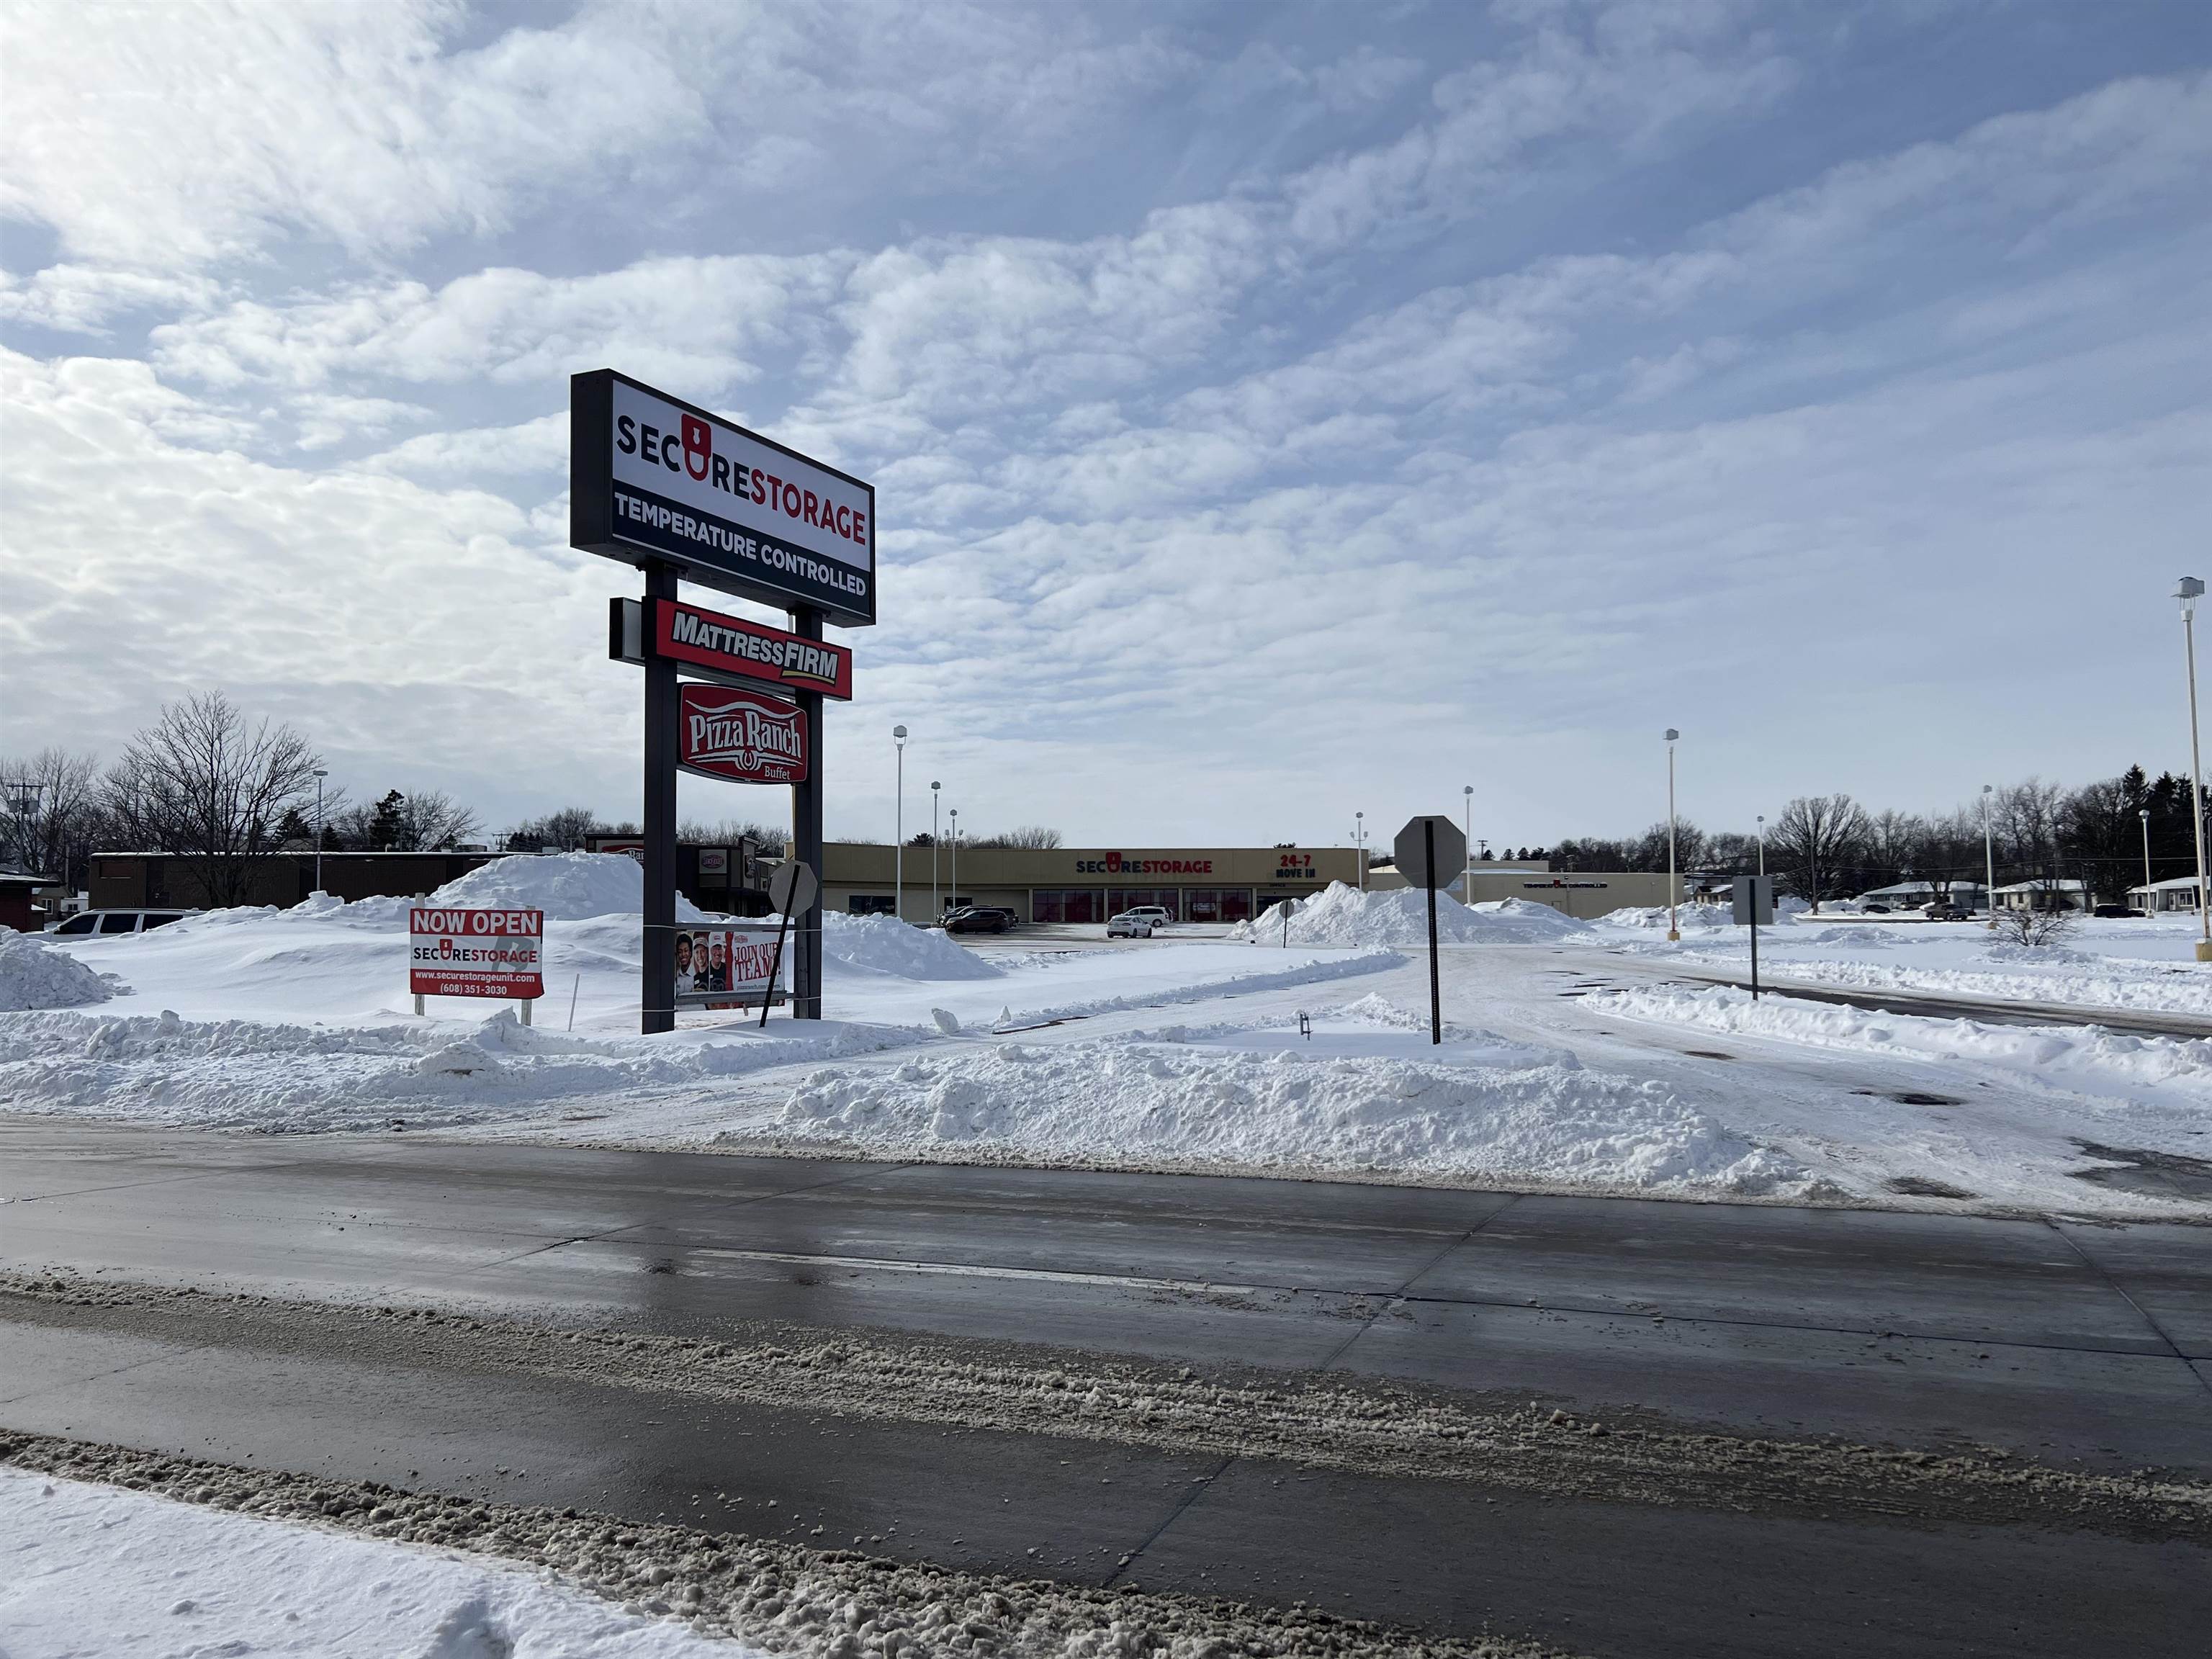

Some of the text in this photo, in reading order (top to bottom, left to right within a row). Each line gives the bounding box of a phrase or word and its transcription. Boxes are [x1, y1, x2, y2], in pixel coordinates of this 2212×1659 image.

[616, 414, 866, 546] SECURESTORAGE
[614, 493, 866, 597] TEMPERATURE CONTROLLED
[689, 711, 801, 758] Pizza Ranch
[765, 765, 791, 781] Buffet
[1076, 853, 1212, 873] SECURESTORAGE
[1280, 855, 1311, 867] 24-7
[1276, 868, 1316, 878] MOVE IN
[414, 911, 537, 934] NOW OPEN
[413, 939, 537, 963] SECURESTORAGE
[734, 945, 757, 963] JOIN
[415, 971, 535, 983] www.securestorageunit.com
[440, 983, 507, 994] (608) 351-3030
